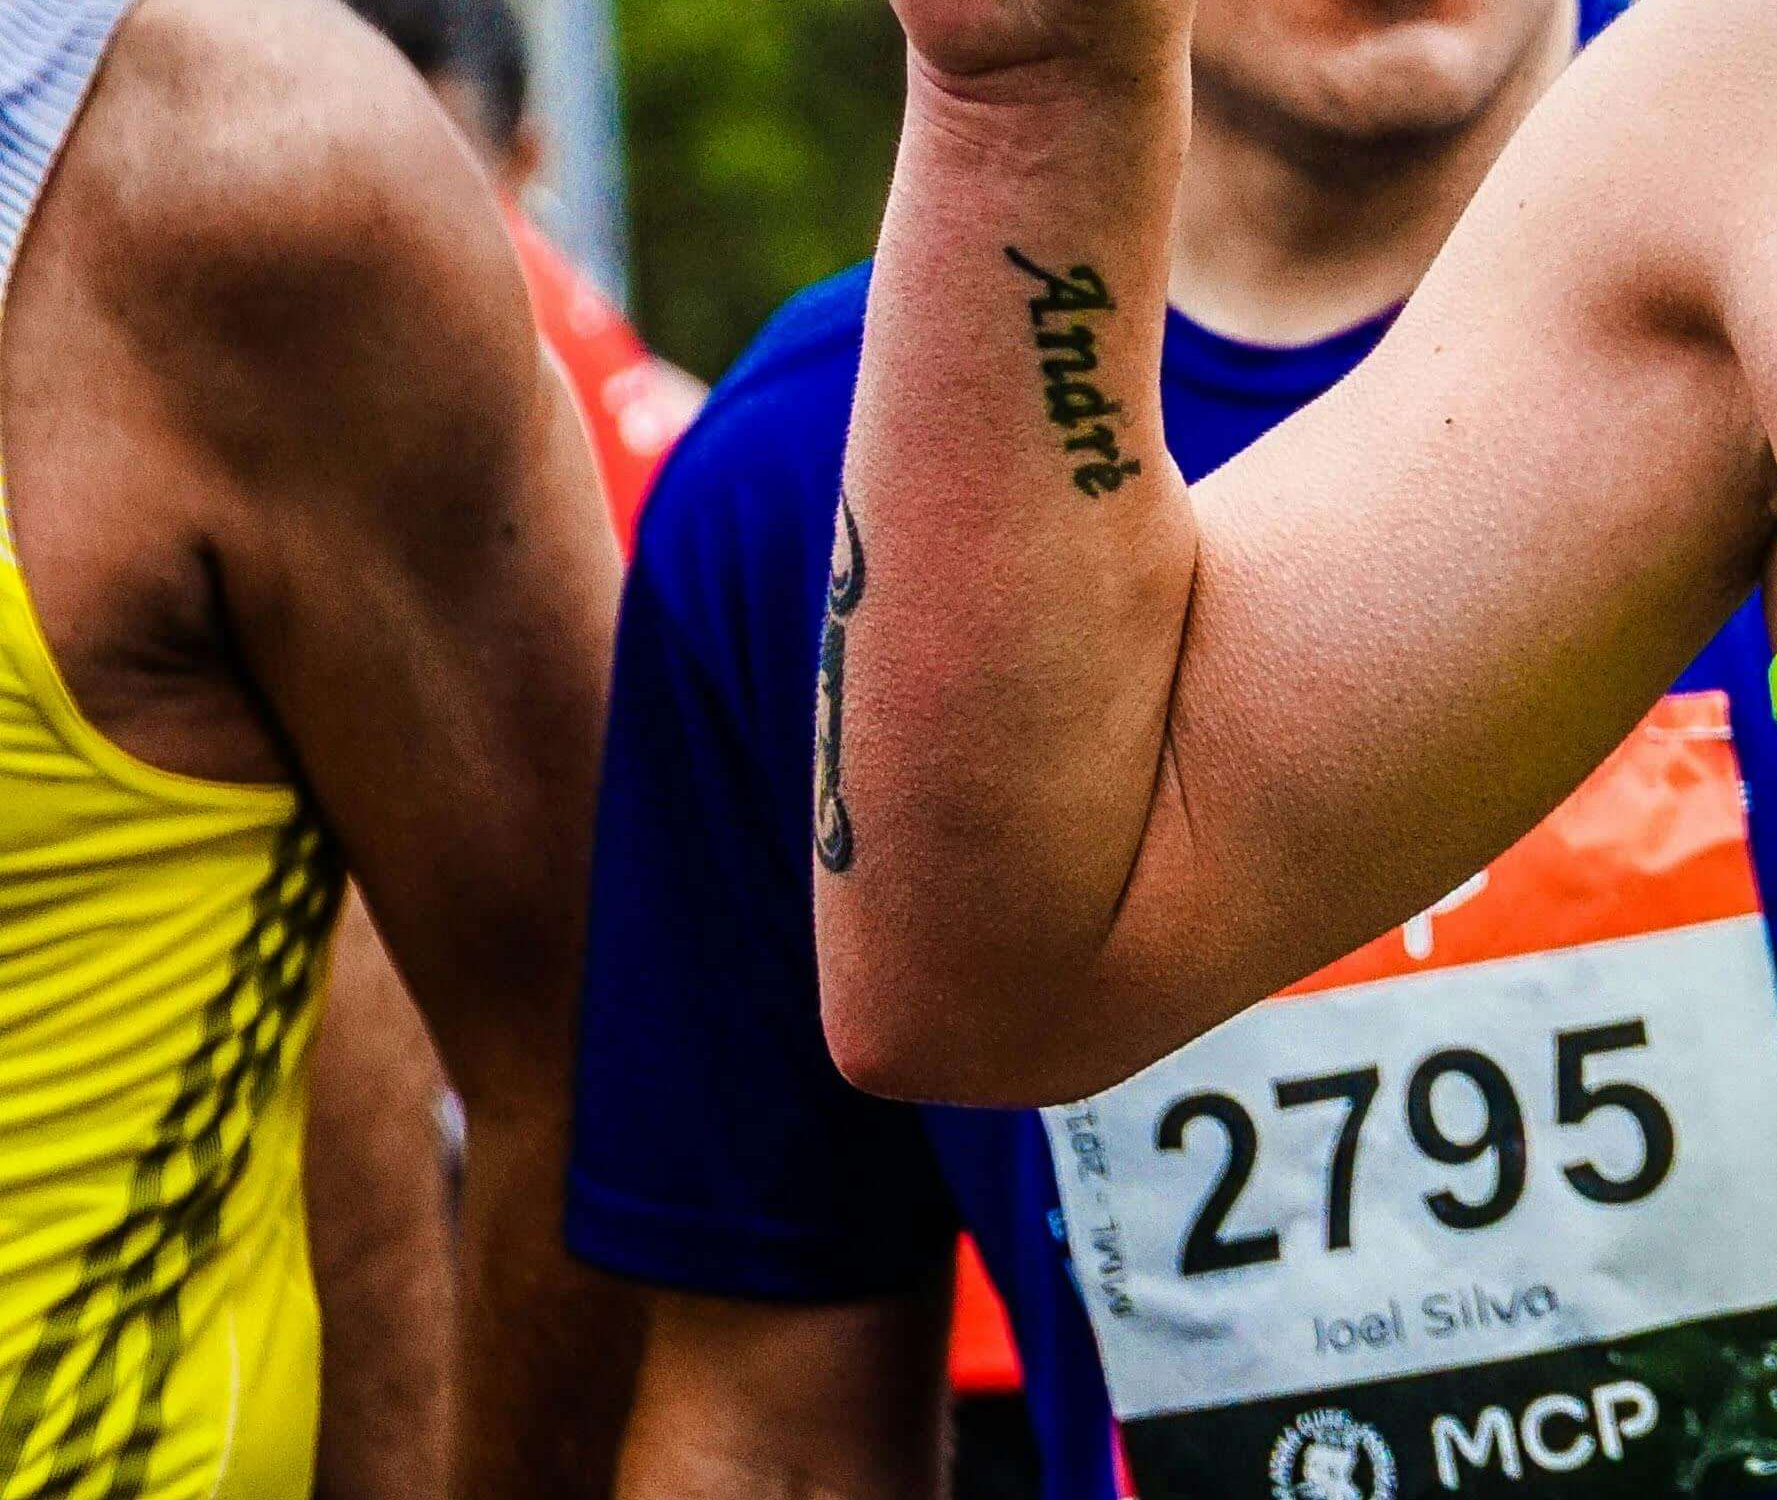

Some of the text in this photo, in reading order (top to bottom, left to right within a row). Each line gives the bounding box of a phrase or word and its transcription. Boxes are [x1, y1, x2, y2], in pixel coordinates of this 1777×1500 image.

[1153, 1015, 1677, 1279] 2795
[1421, 1280, 1560, 1340] Silva
[1430, 1379, 1660, 1492] MCP
